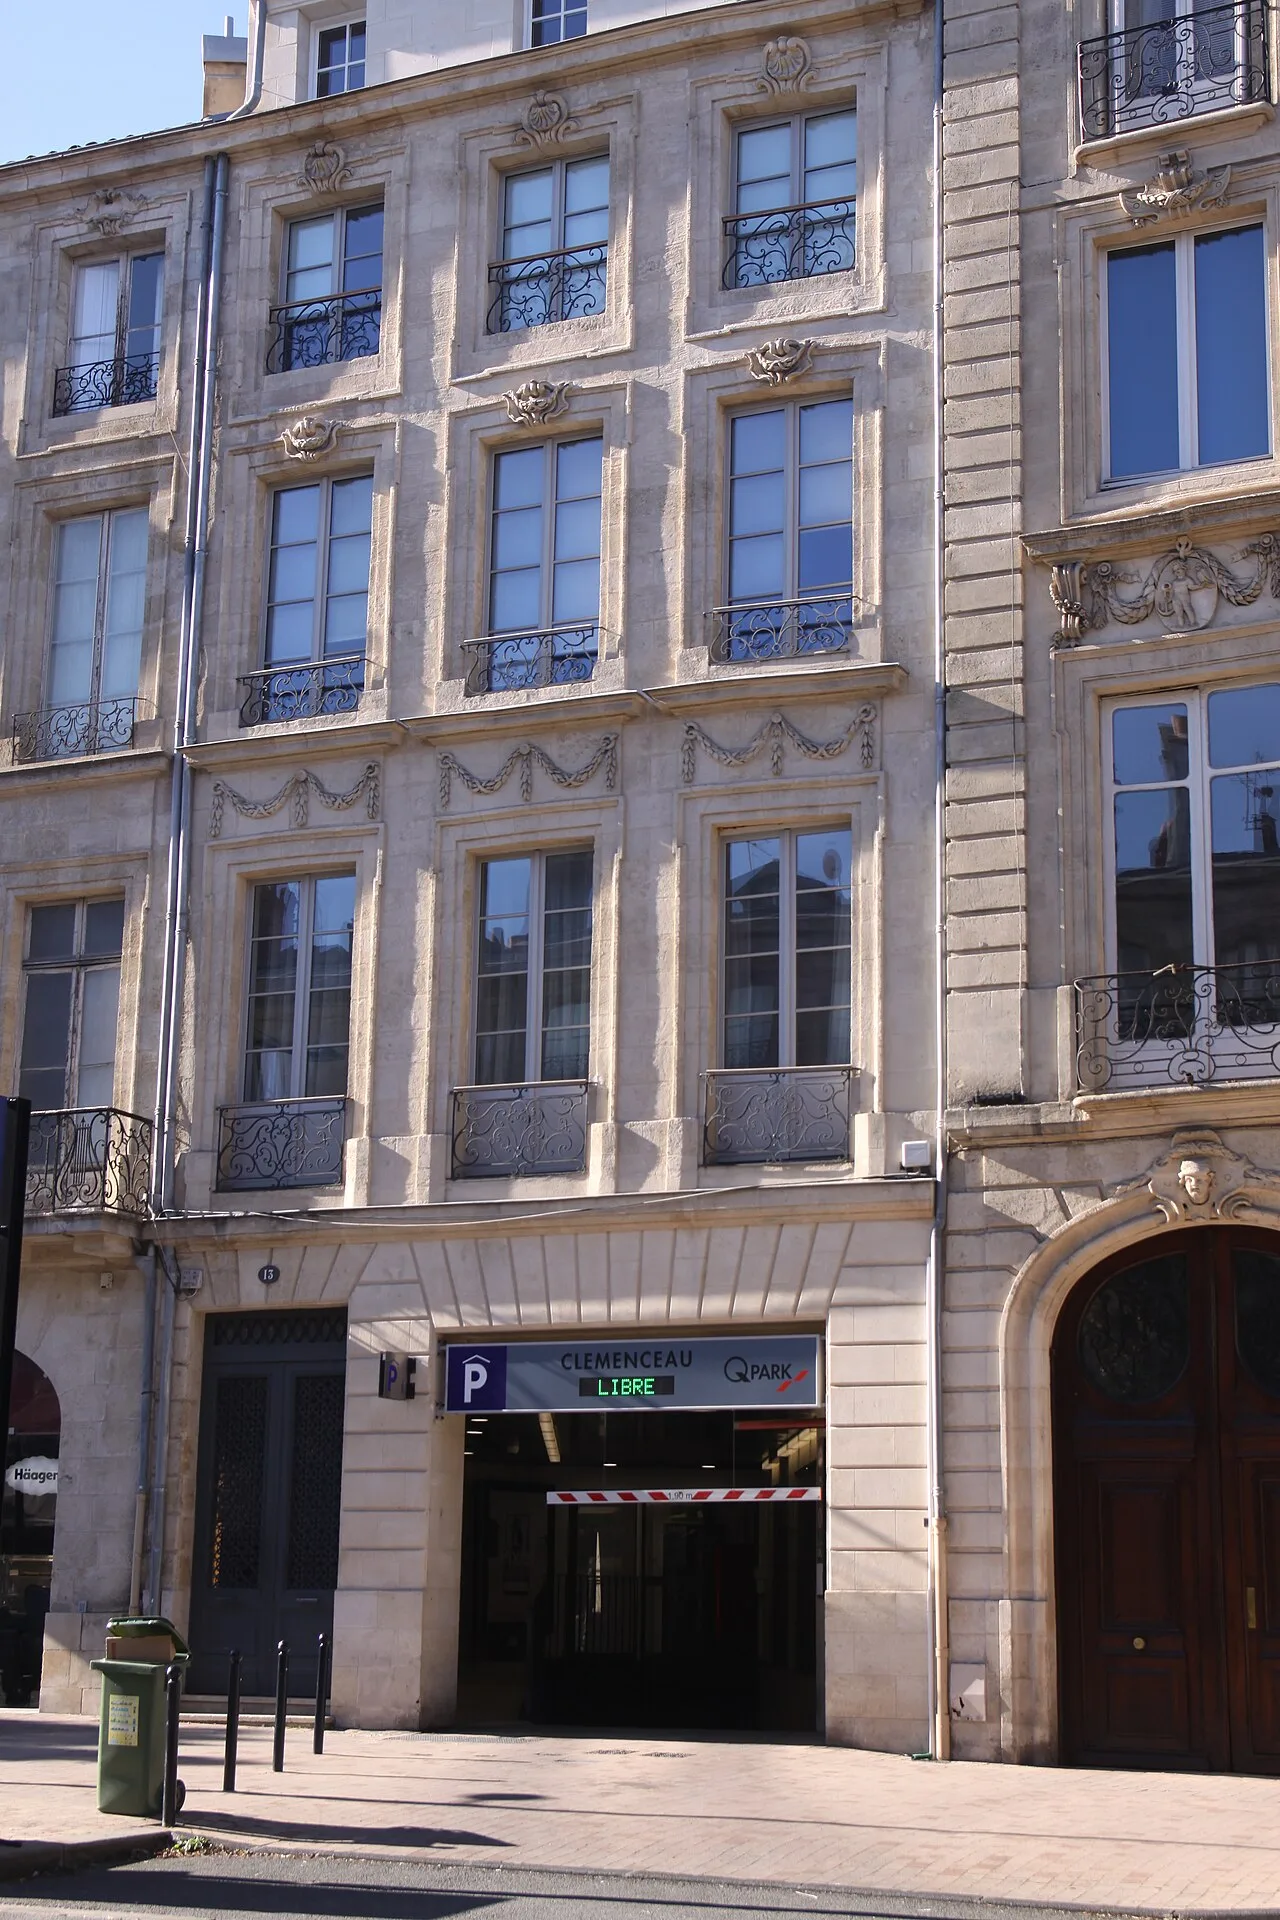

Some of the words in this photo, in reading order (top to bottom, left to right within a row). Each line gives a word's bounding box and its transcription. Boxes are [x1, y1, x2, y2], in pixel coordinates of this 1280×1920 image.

[263, 1269, 274, 1280] 13
[560, 1350, 693, 1370] CLEMENCEAU
[387, 1365, 398, 1392] P
[464, 1363, 488, 1403] P
[598, 1378, 655, 1396] LIBRE
[685, 1492, 693, 1500] m
